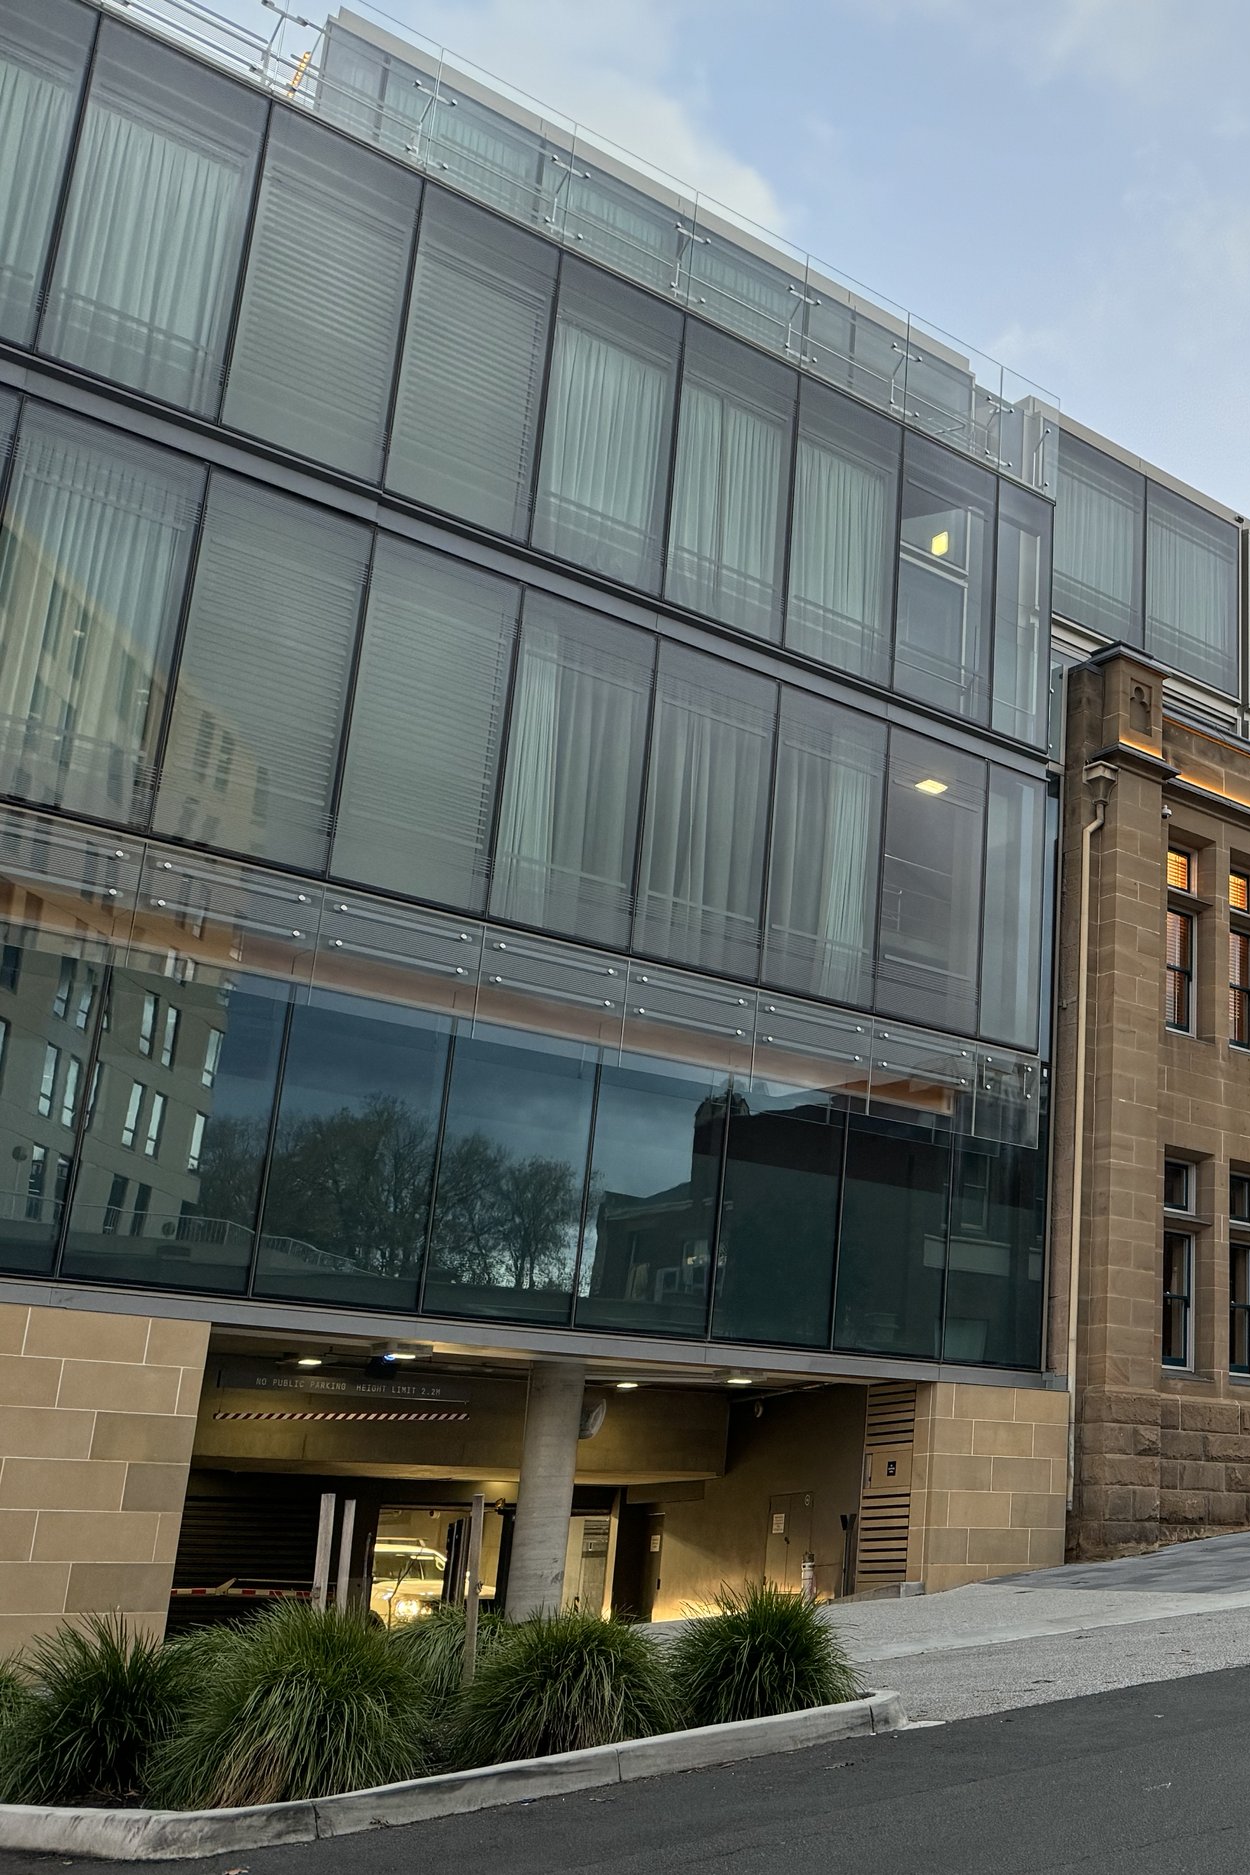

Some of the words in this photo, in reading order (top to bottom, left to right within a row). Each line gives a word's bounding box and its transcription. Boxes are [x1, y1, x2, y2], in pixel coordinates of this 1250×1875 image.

[256, 1377, 267, 1386] NO
[273, 1378, 305, 1388] PUBLIC
[310, 1380, 346, 1390] PARKING
[356, 1383, 386, 1393] HEIGHT
[391, 1385, 416, 1394] LIMIT
[421, 1387, 441, 1396] 2.2M
